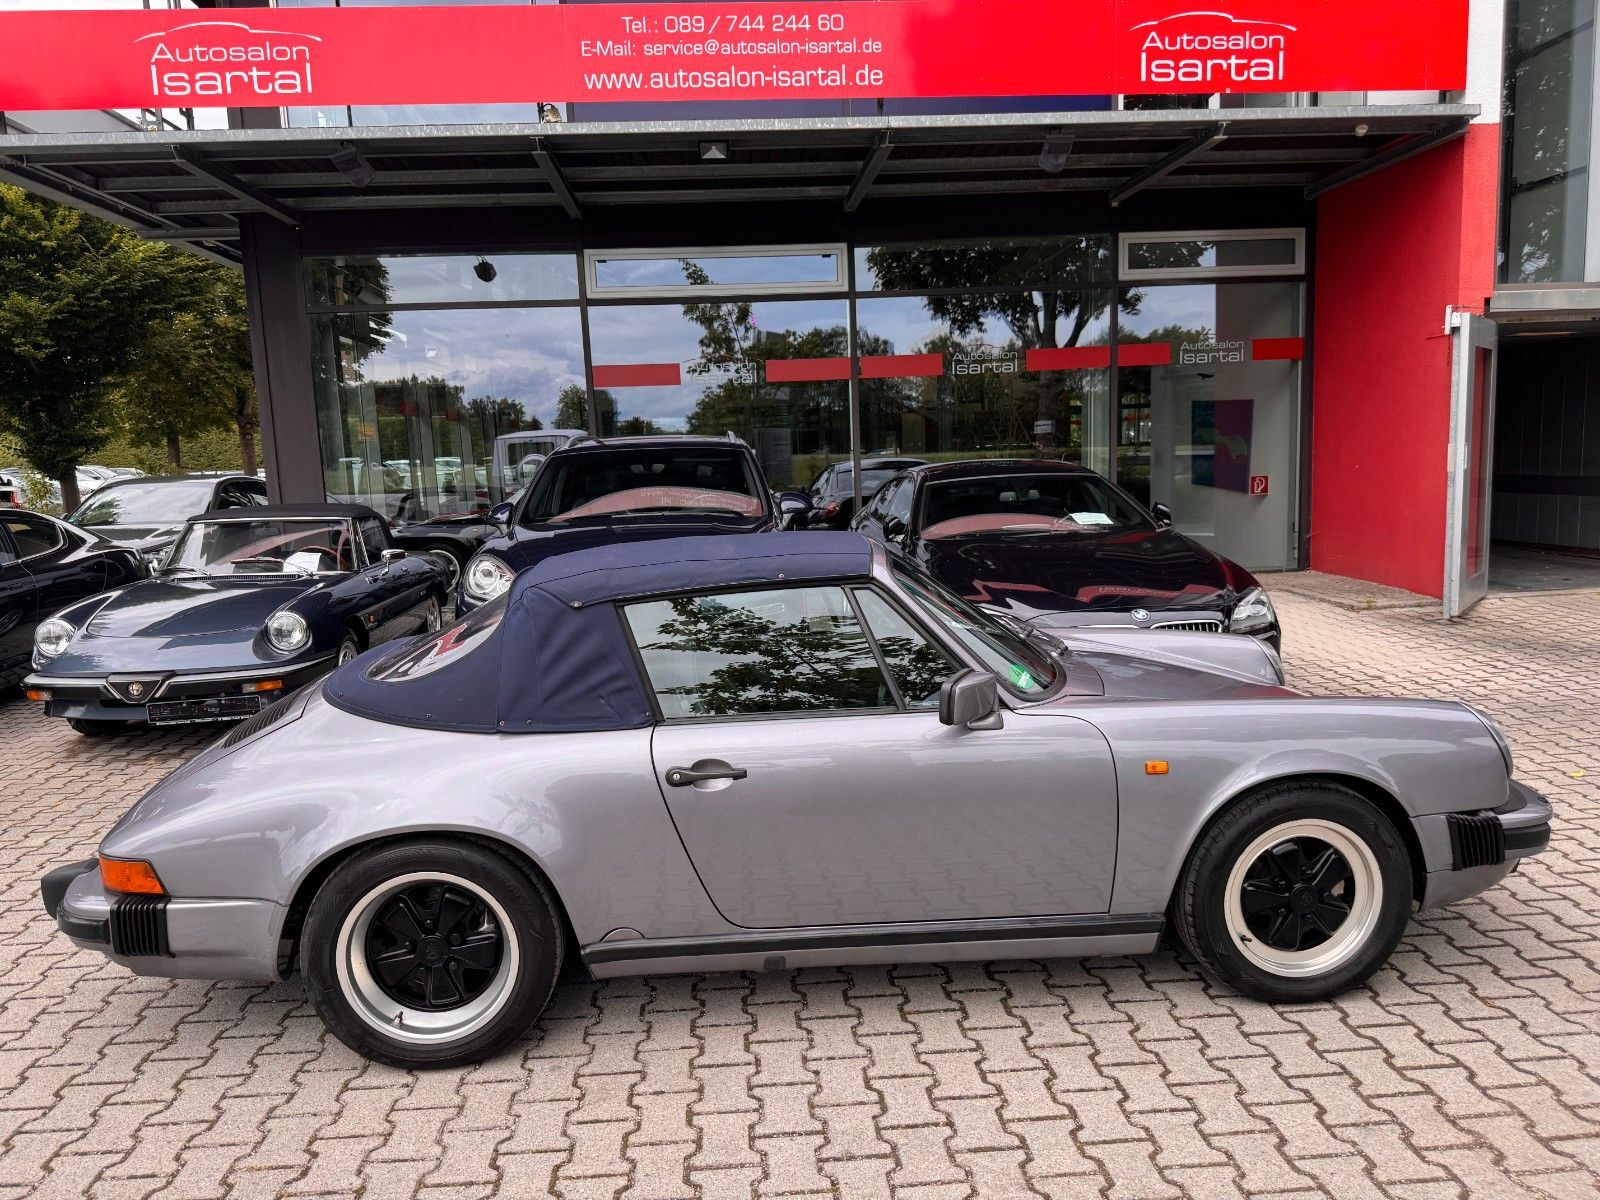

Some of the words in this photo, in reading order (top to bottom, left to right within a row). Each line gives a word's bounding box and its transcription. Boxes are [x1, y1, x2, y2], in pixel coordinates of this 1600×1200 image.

[620, 15, 659, 34] Tel.:
[663, 14, 705, 33] 089
[725, 14, 766, 33] 744
[771, 13, 811, 32] 244
[817, 13, 845, 31] 60
[580, 39, 637, 57] E-Mail:
[643, 37, 883, 56] service@autosalon-isartal.de
[1141, 30, 1285, 50] Autosalon
[150, 41, 310, 63] Autosalon
[1140, 50, 1285, 82] Isartal
[150, 62, 313, 96] Isartal
[583, 64, 884, 90] www.autosalon-isartal.de
[1180, 340, 1244, 350] Autosalon
[952, 350, 1018, 361] Autosalon
[1179, 348, 1244, 364] Isartal
[951, 358, 1018, 375] Isartal
